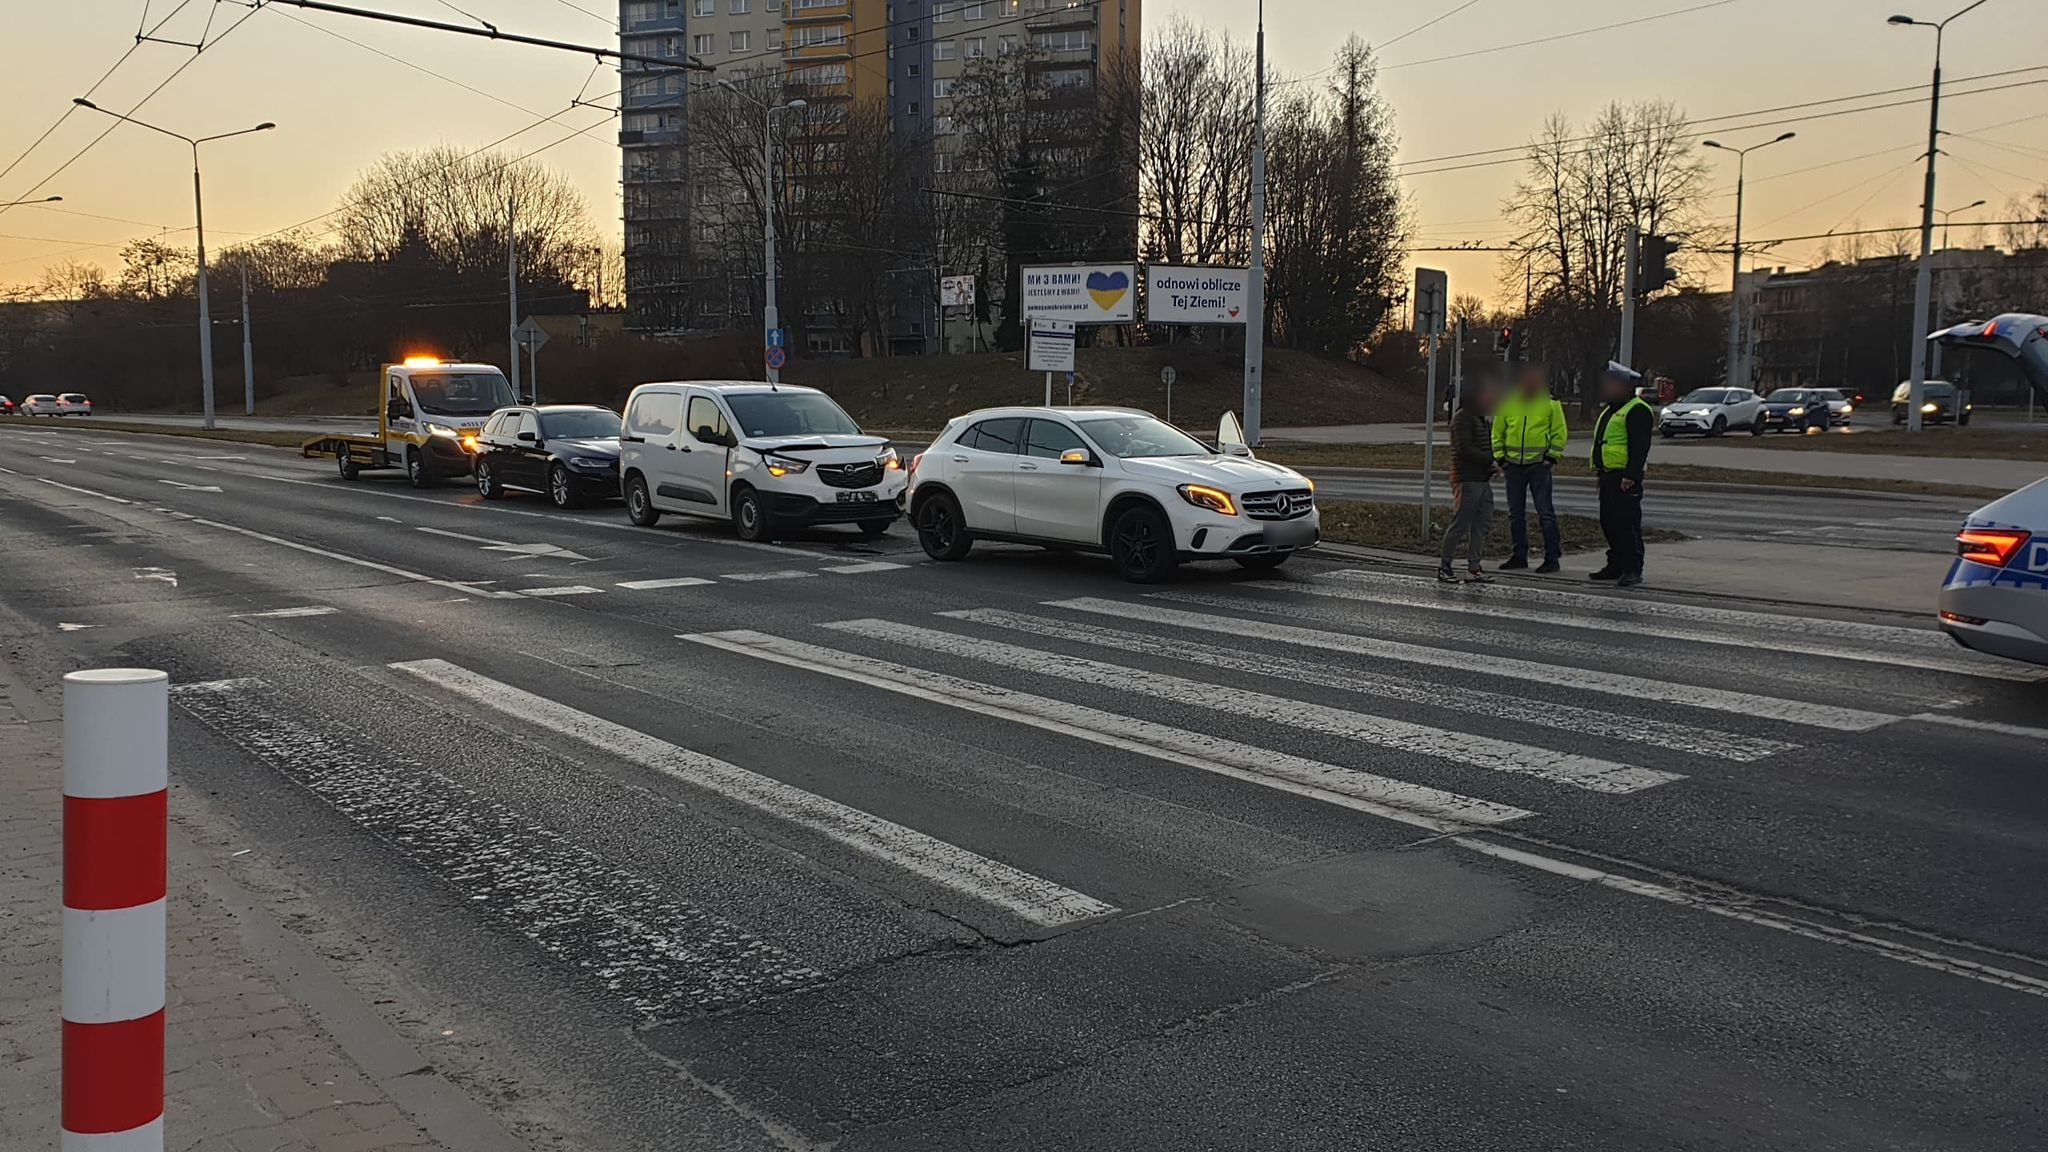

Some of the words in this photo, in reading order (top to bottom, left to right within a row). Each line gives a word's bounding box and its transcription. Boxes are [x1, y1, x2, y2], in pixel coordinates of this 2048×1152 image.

[1027, 274, 1041, 285] МИ
[1052, 273, 1081, 285] ВАМИ!
[1156, 276, 1199, 290] odnowi
[1201, 278, 1241, 291] oblicze
[1171, 295, 1188, 310] Tej
[1190, 295, 1226, 308] Ziemi!
